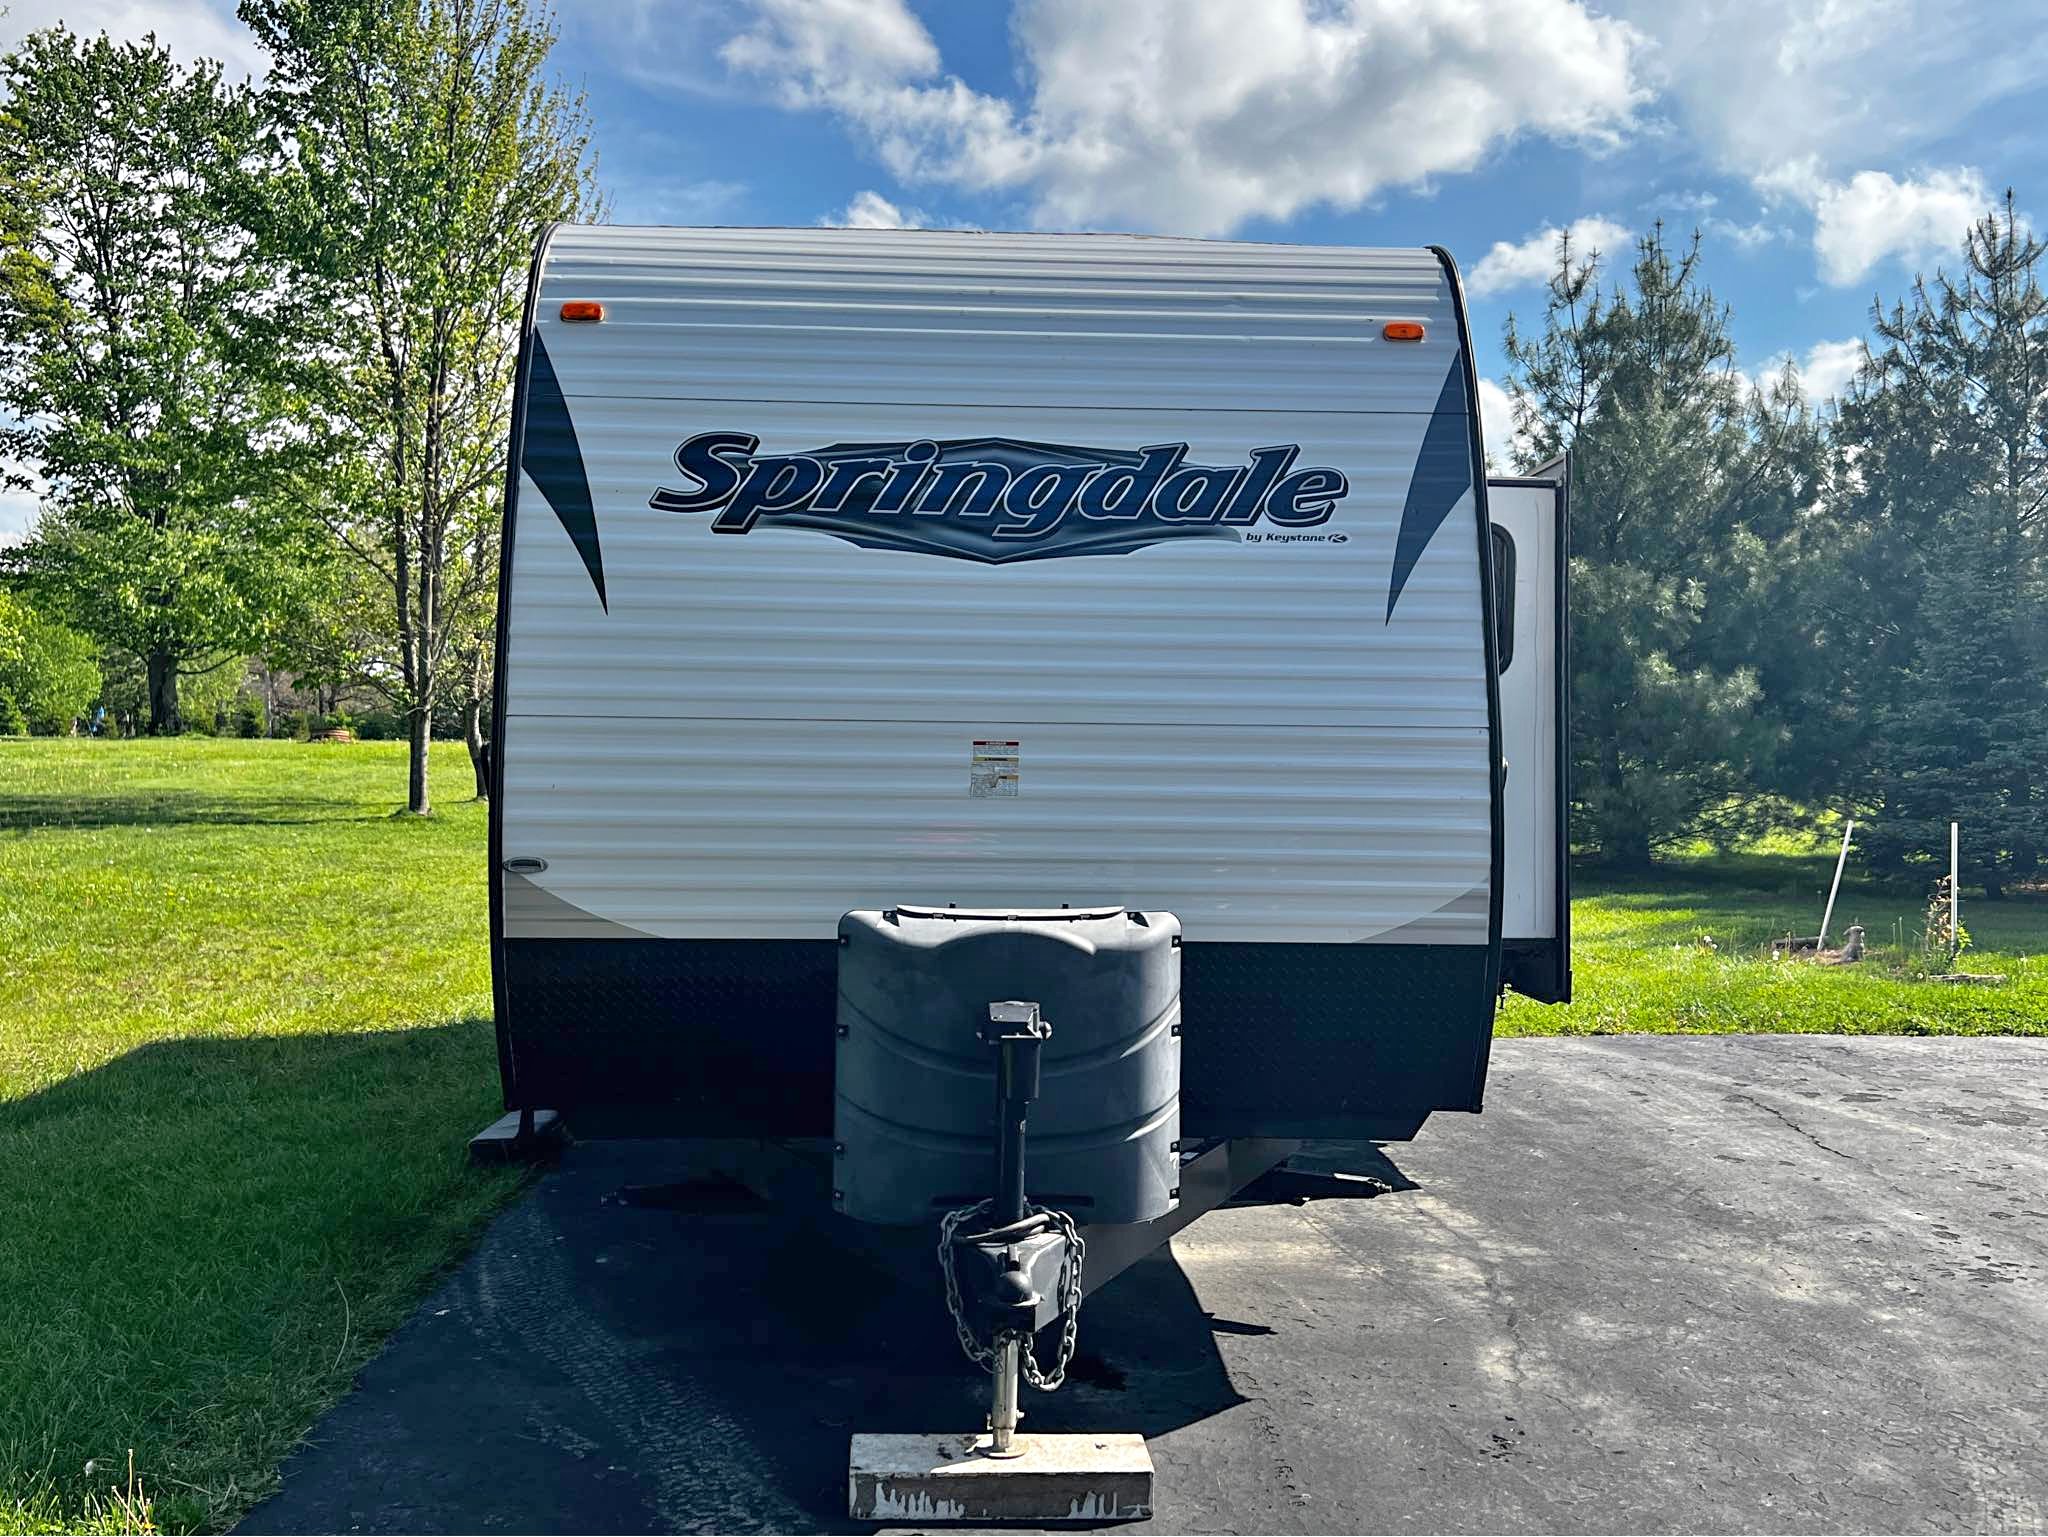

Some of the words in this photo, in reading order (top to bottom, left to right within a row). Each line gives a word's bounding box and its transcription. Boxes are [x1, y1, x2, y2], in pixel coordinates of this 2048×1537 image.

[649, 431, 1348, 536] Springdale
[1246, 532, 1262, 543] by
[1266, 532, 1326, 543] Keystone
